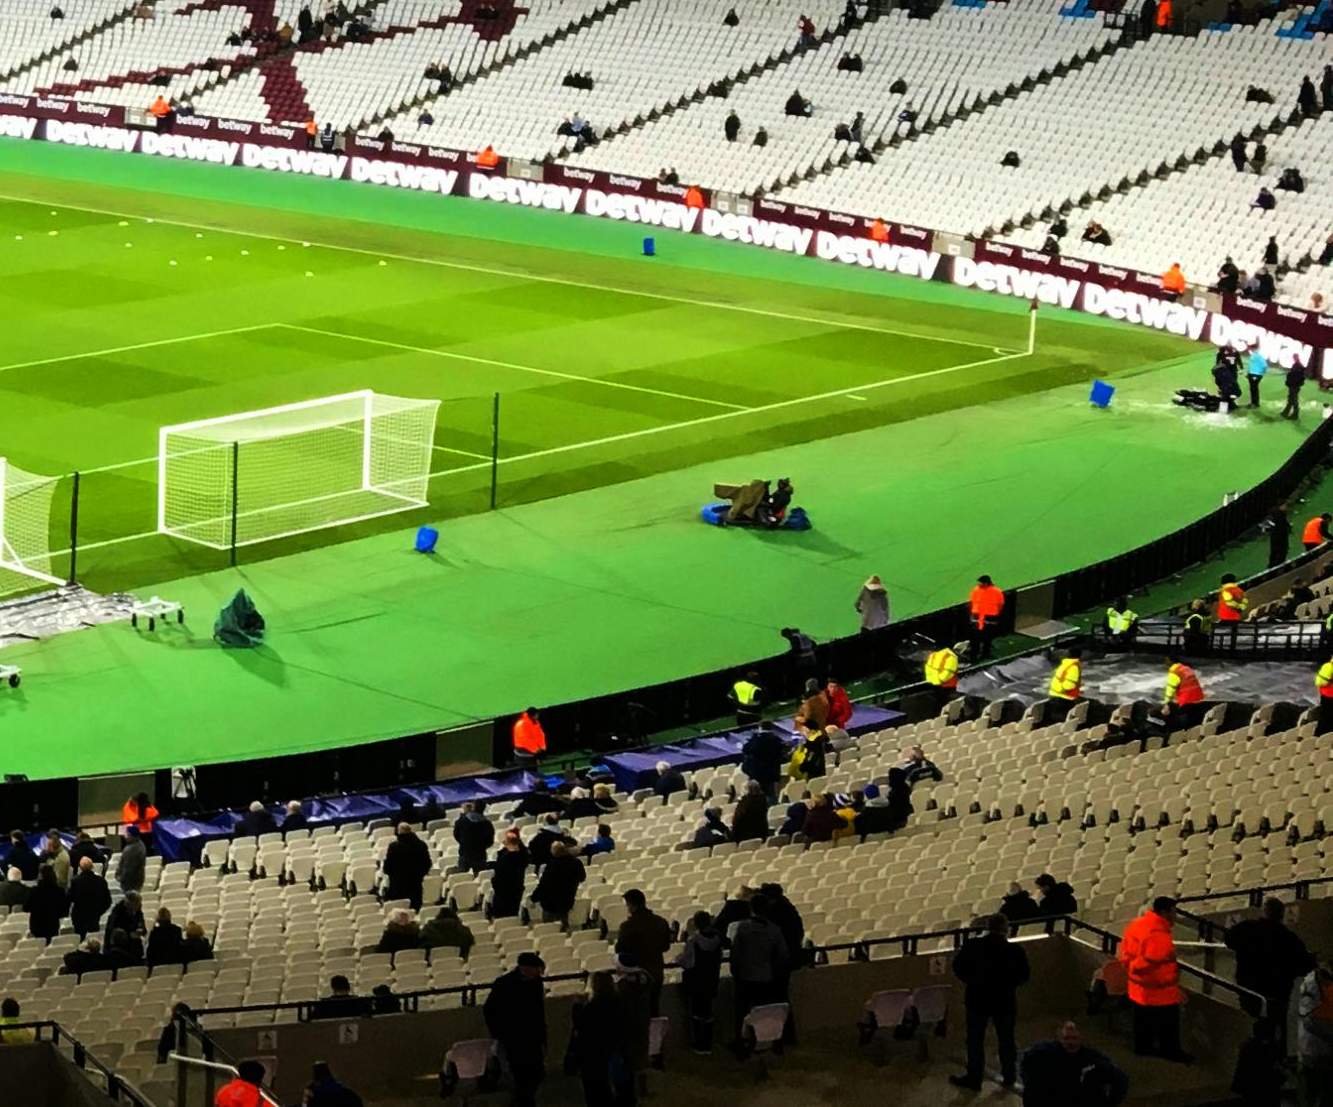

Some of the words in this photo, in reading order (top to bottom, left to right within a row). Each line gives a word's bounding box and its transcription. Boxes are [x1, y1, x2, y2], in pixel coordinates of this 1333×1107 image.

[37, 98, 69, 113] betway
[77, 101, 110, 117] betway
[176, 114, 210, 129] betway
[218, 119, 252, 135] betway
[260, 124, 294, 140] betway
